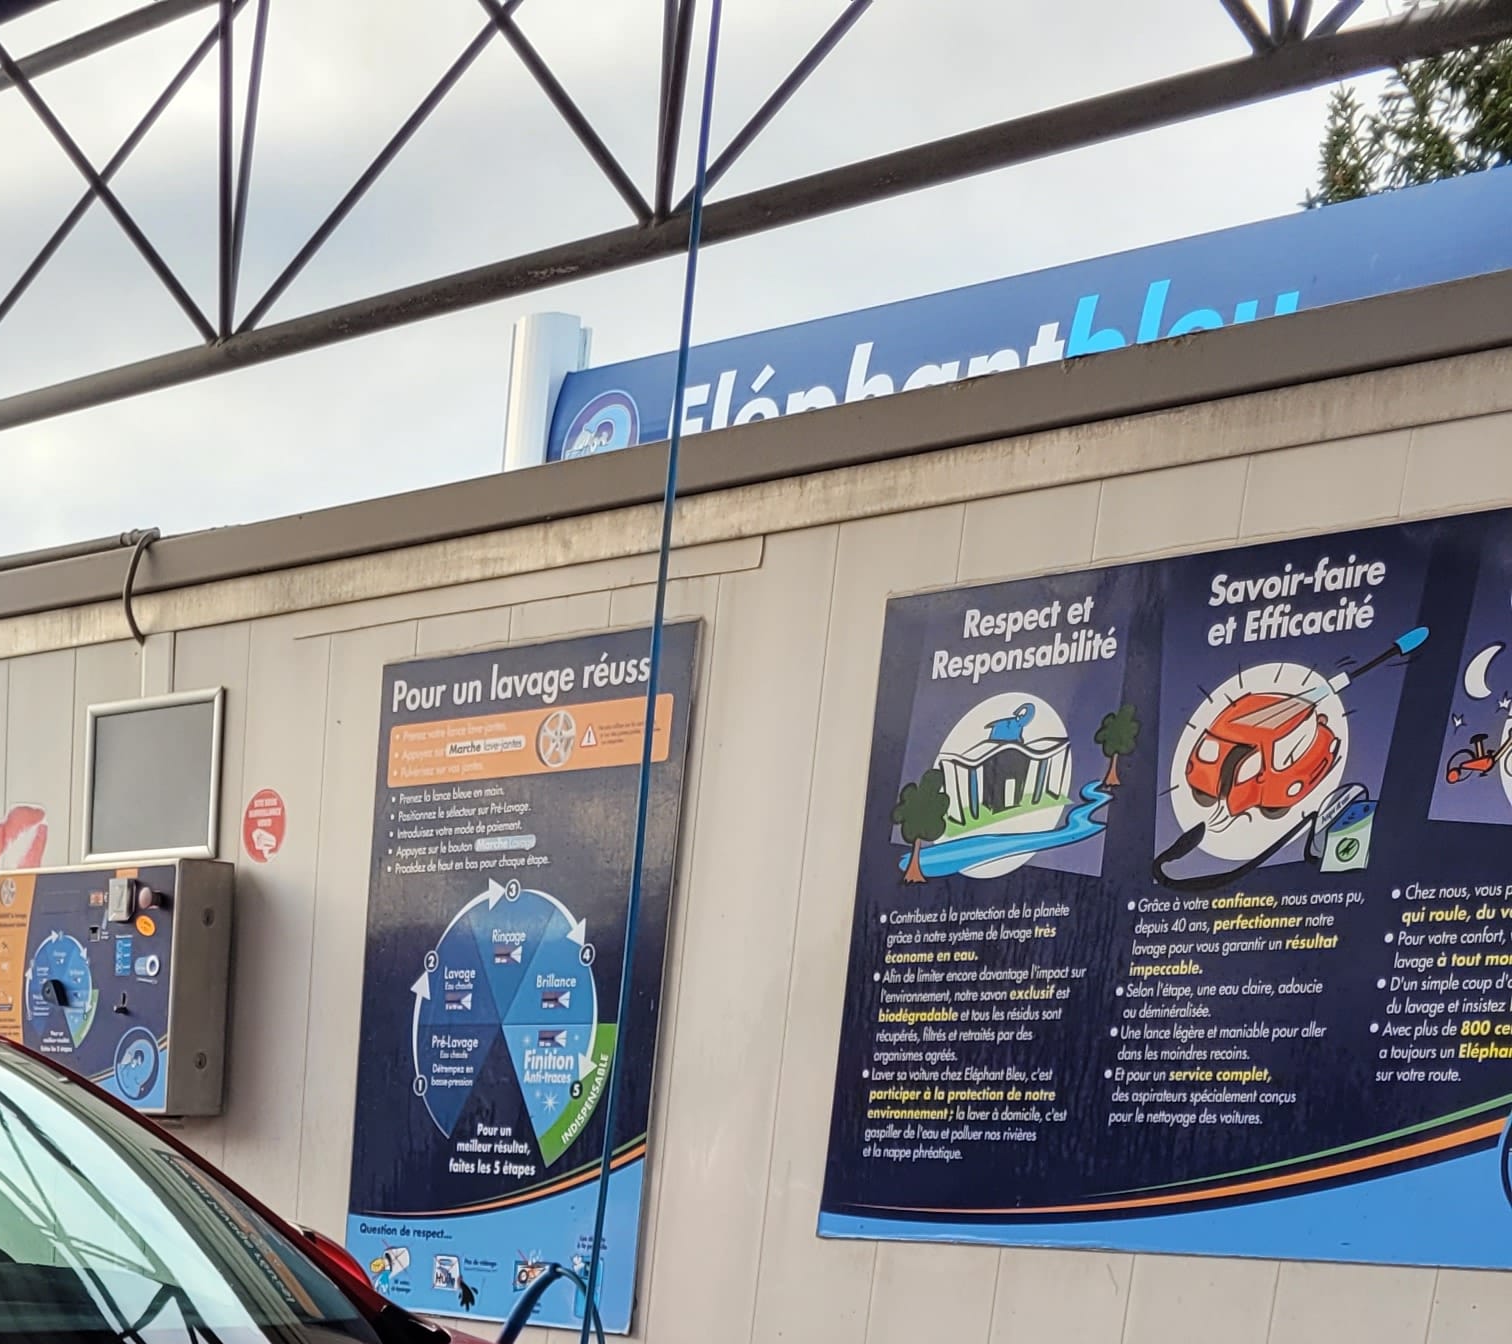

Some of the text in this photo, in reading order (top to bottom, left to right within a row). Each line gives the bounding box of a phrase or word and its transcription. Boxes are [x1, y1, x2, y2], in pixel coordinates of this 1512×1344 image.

[1208, 554, 1386, 607] Savoir-faire
[963, 596, 1094, 644] Respect et
[1207, 593, 1374, 647] et Efficacité
[932, 627, 1117, 684] Responsabilité
[392, 652, 651, 712] Pour un lavage réuss
[449, 744, 481, 755] Marche
[509, 883, 516, 897] 3
[1138, 893, 1364, 913] Grâce à votre confiance, nous avons pu,
[890, 902, 1069, 924] Contribuez à la protection de la planète
[1402, 904, 1495, 927] qui roule, du
[1135, 911, 1334, 937] depuis 40 ans, perfectionner notre
[492, 929, 526, 945] Rinçage
[1132, 932, 1338, 958] lavage pour vous garantir un résultat
[1398, 926, 1505, 946] Pour votre confort,
[428, 956, 434, 967] 2
[582, 949, 590, 960] 4
[885, 951, 978, 964] économe en eau.
[1394, 952, 1481, 972] lavage à tout
[444, 967, 476, 982] Lavage
[1129, 960, 1203, 979] impeccable.
[537, 973, 576, 988] Brillance
[1126, 978, 1323, 1000] Selon l'étape, une eau claire, adoucie
[1390, 973, 1492, 994] D'un simple coup
[1123, 1001, 1211, 1018] ou déminéralisée.
[1386, 997, 1505, 1018] du lavage et insistez
[1382, 1019, 1490, 1039] Avec plus de 800
[432, 1035, 479, 1051] Pré-Lavage
[524, 1048, 574, 1070] Finition
[1379, 1049, 1387, 1059] a
[1390, 1045, 1436, 1063] toujours
[1440, 1048, 1455, 1058] un
[524, 1071, 571, 1084] Anti-traces
[1115, 1065, 1272, 1085] Et pour un service complet,
[1376, 1068, 1462, 1082] sur votre route.
[561, 1054, 609, 1144] INDISPENSABLE
[573, 1084, 580, 1096] 5
[477, 1123, 512, 1136] Pour un
[457, 1141, 531, 1155] meilleur résultat,
[449, 1159, 536, 1178] faites les 5 étapes
[360, 1223, 397, 1236] Question
[400, 1224, 411, 1237] de
